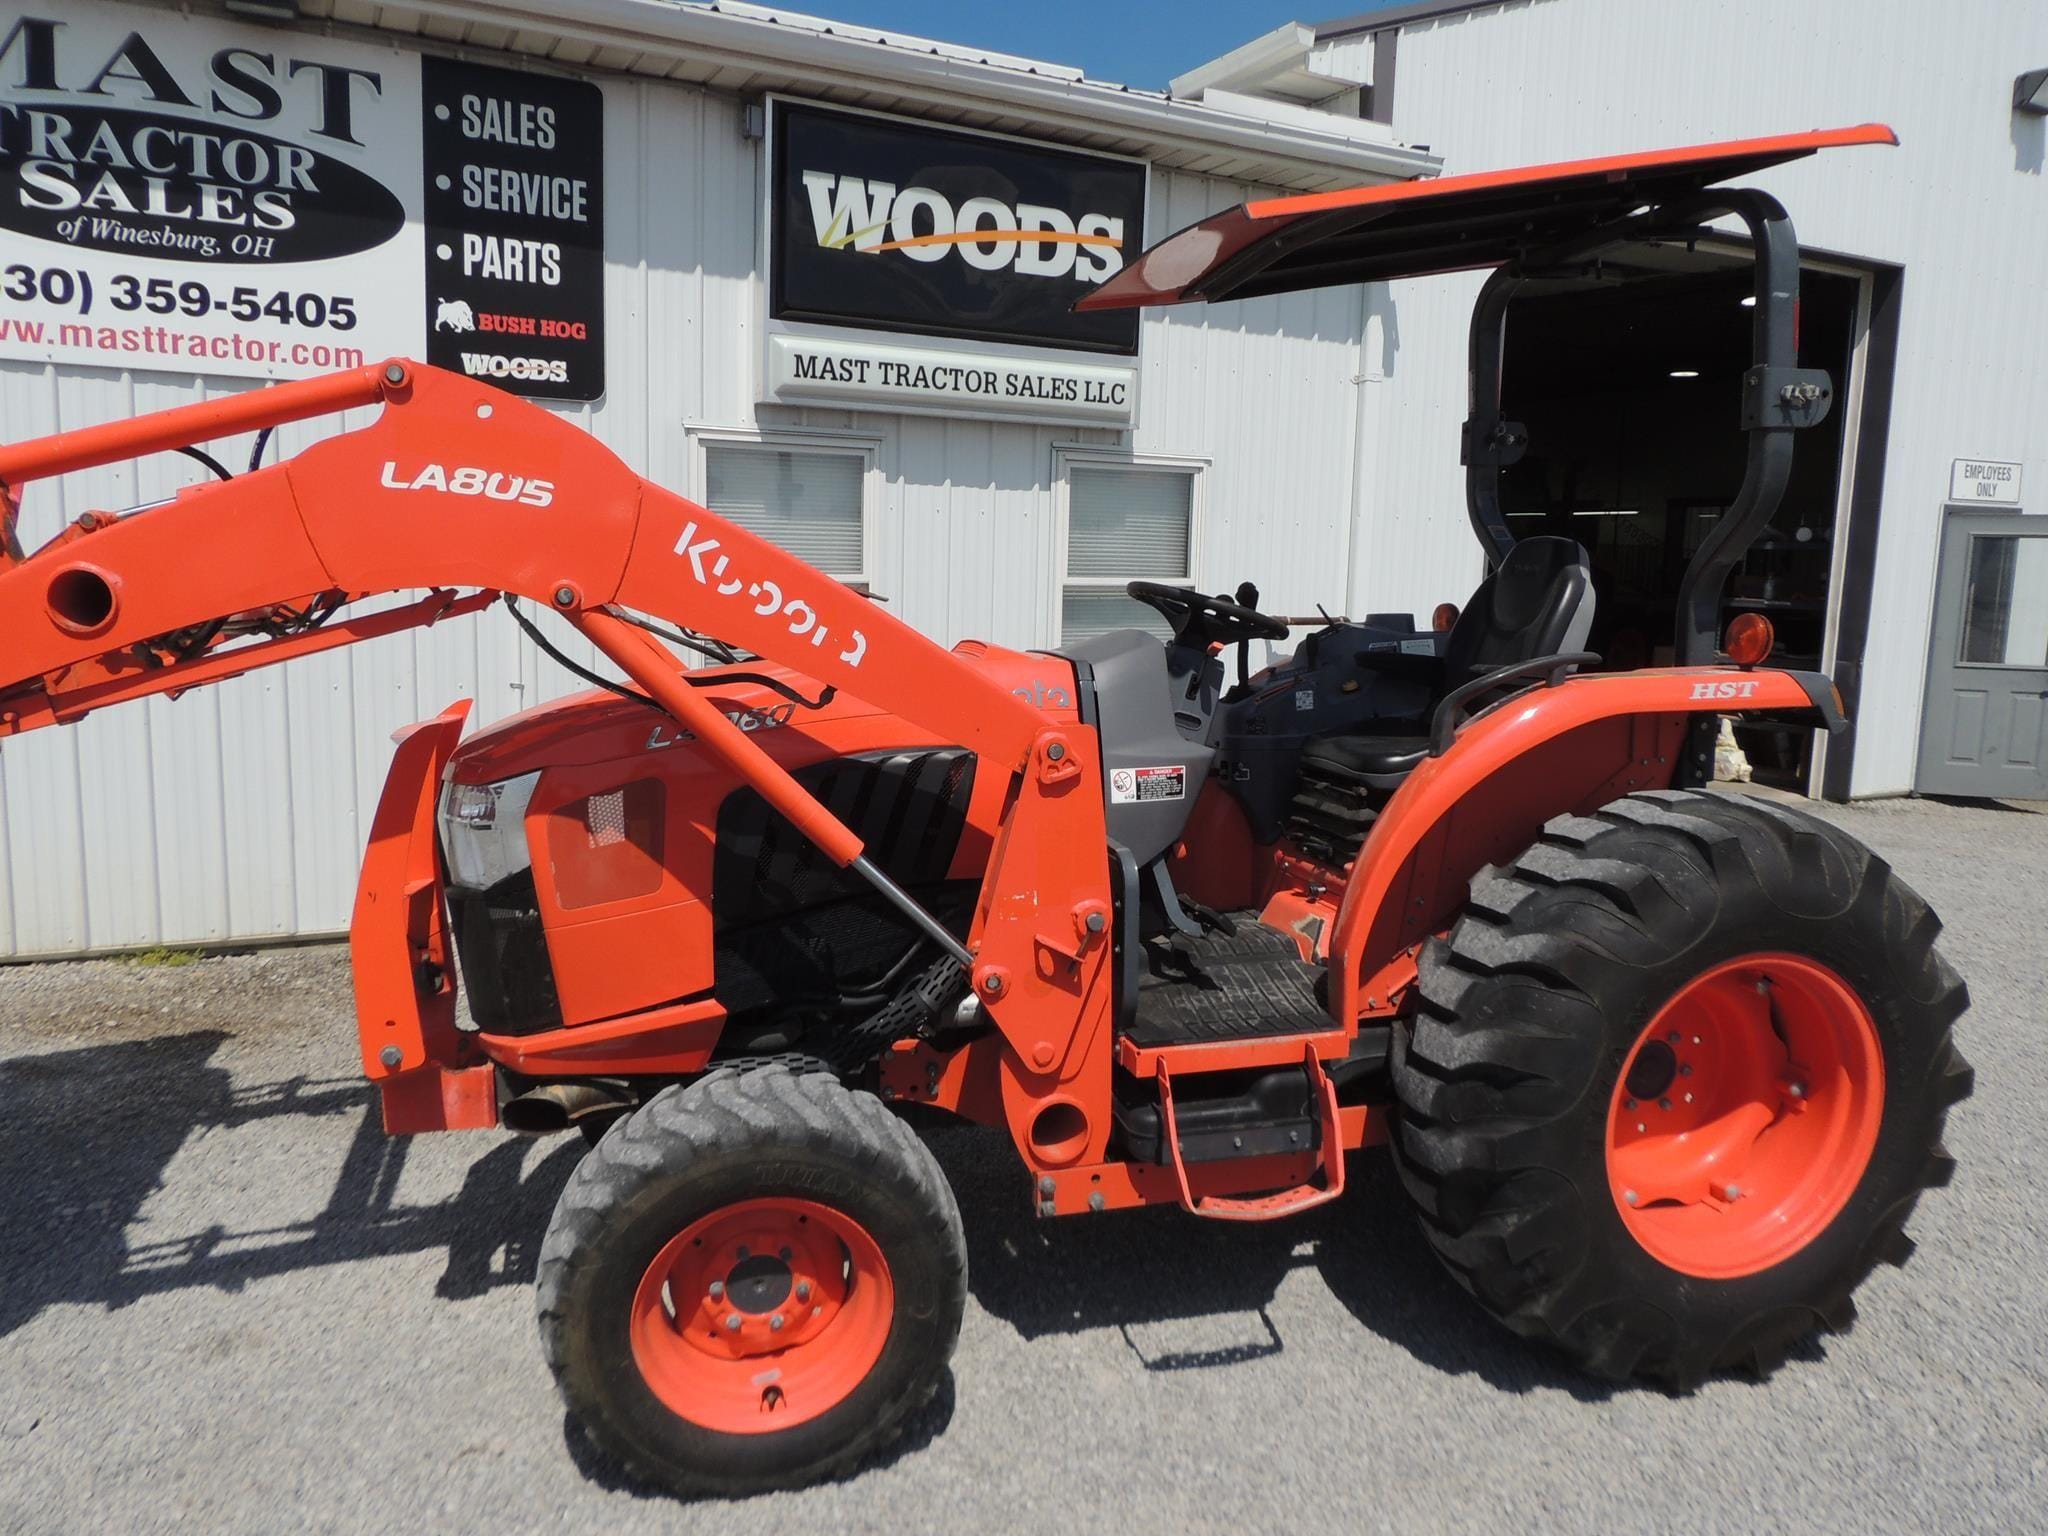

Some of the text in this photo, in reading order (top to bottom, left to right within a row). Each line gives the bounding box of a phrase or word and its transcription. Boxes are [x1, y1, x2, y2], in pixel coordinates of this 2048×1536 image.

[462, 94, 556, 150] SALES
[19, 159, 296, 231] SALES
[462, 164, 588, 222] SERVICE
[56, 216, 275, 258] of Winesburg, OH
[802, 169, 1124, 284] WOODS
[463, 233, 561, 286] PARTS
[0, 264, 357, 331] 30) 359-5405
[478, 313, 587, 340] BUSH HOG
[461, 352, 567, 383] WOODS
[793, 354, 1126, 405] MAST TRACTOR SALES LLC
[380, 461, 555, 508] LA805
[1964, 463, 2012, 482] EMPLOYEES
[1976, 482, 1998, 498] ONLY
[1689, 681, 1760, 701] HST
